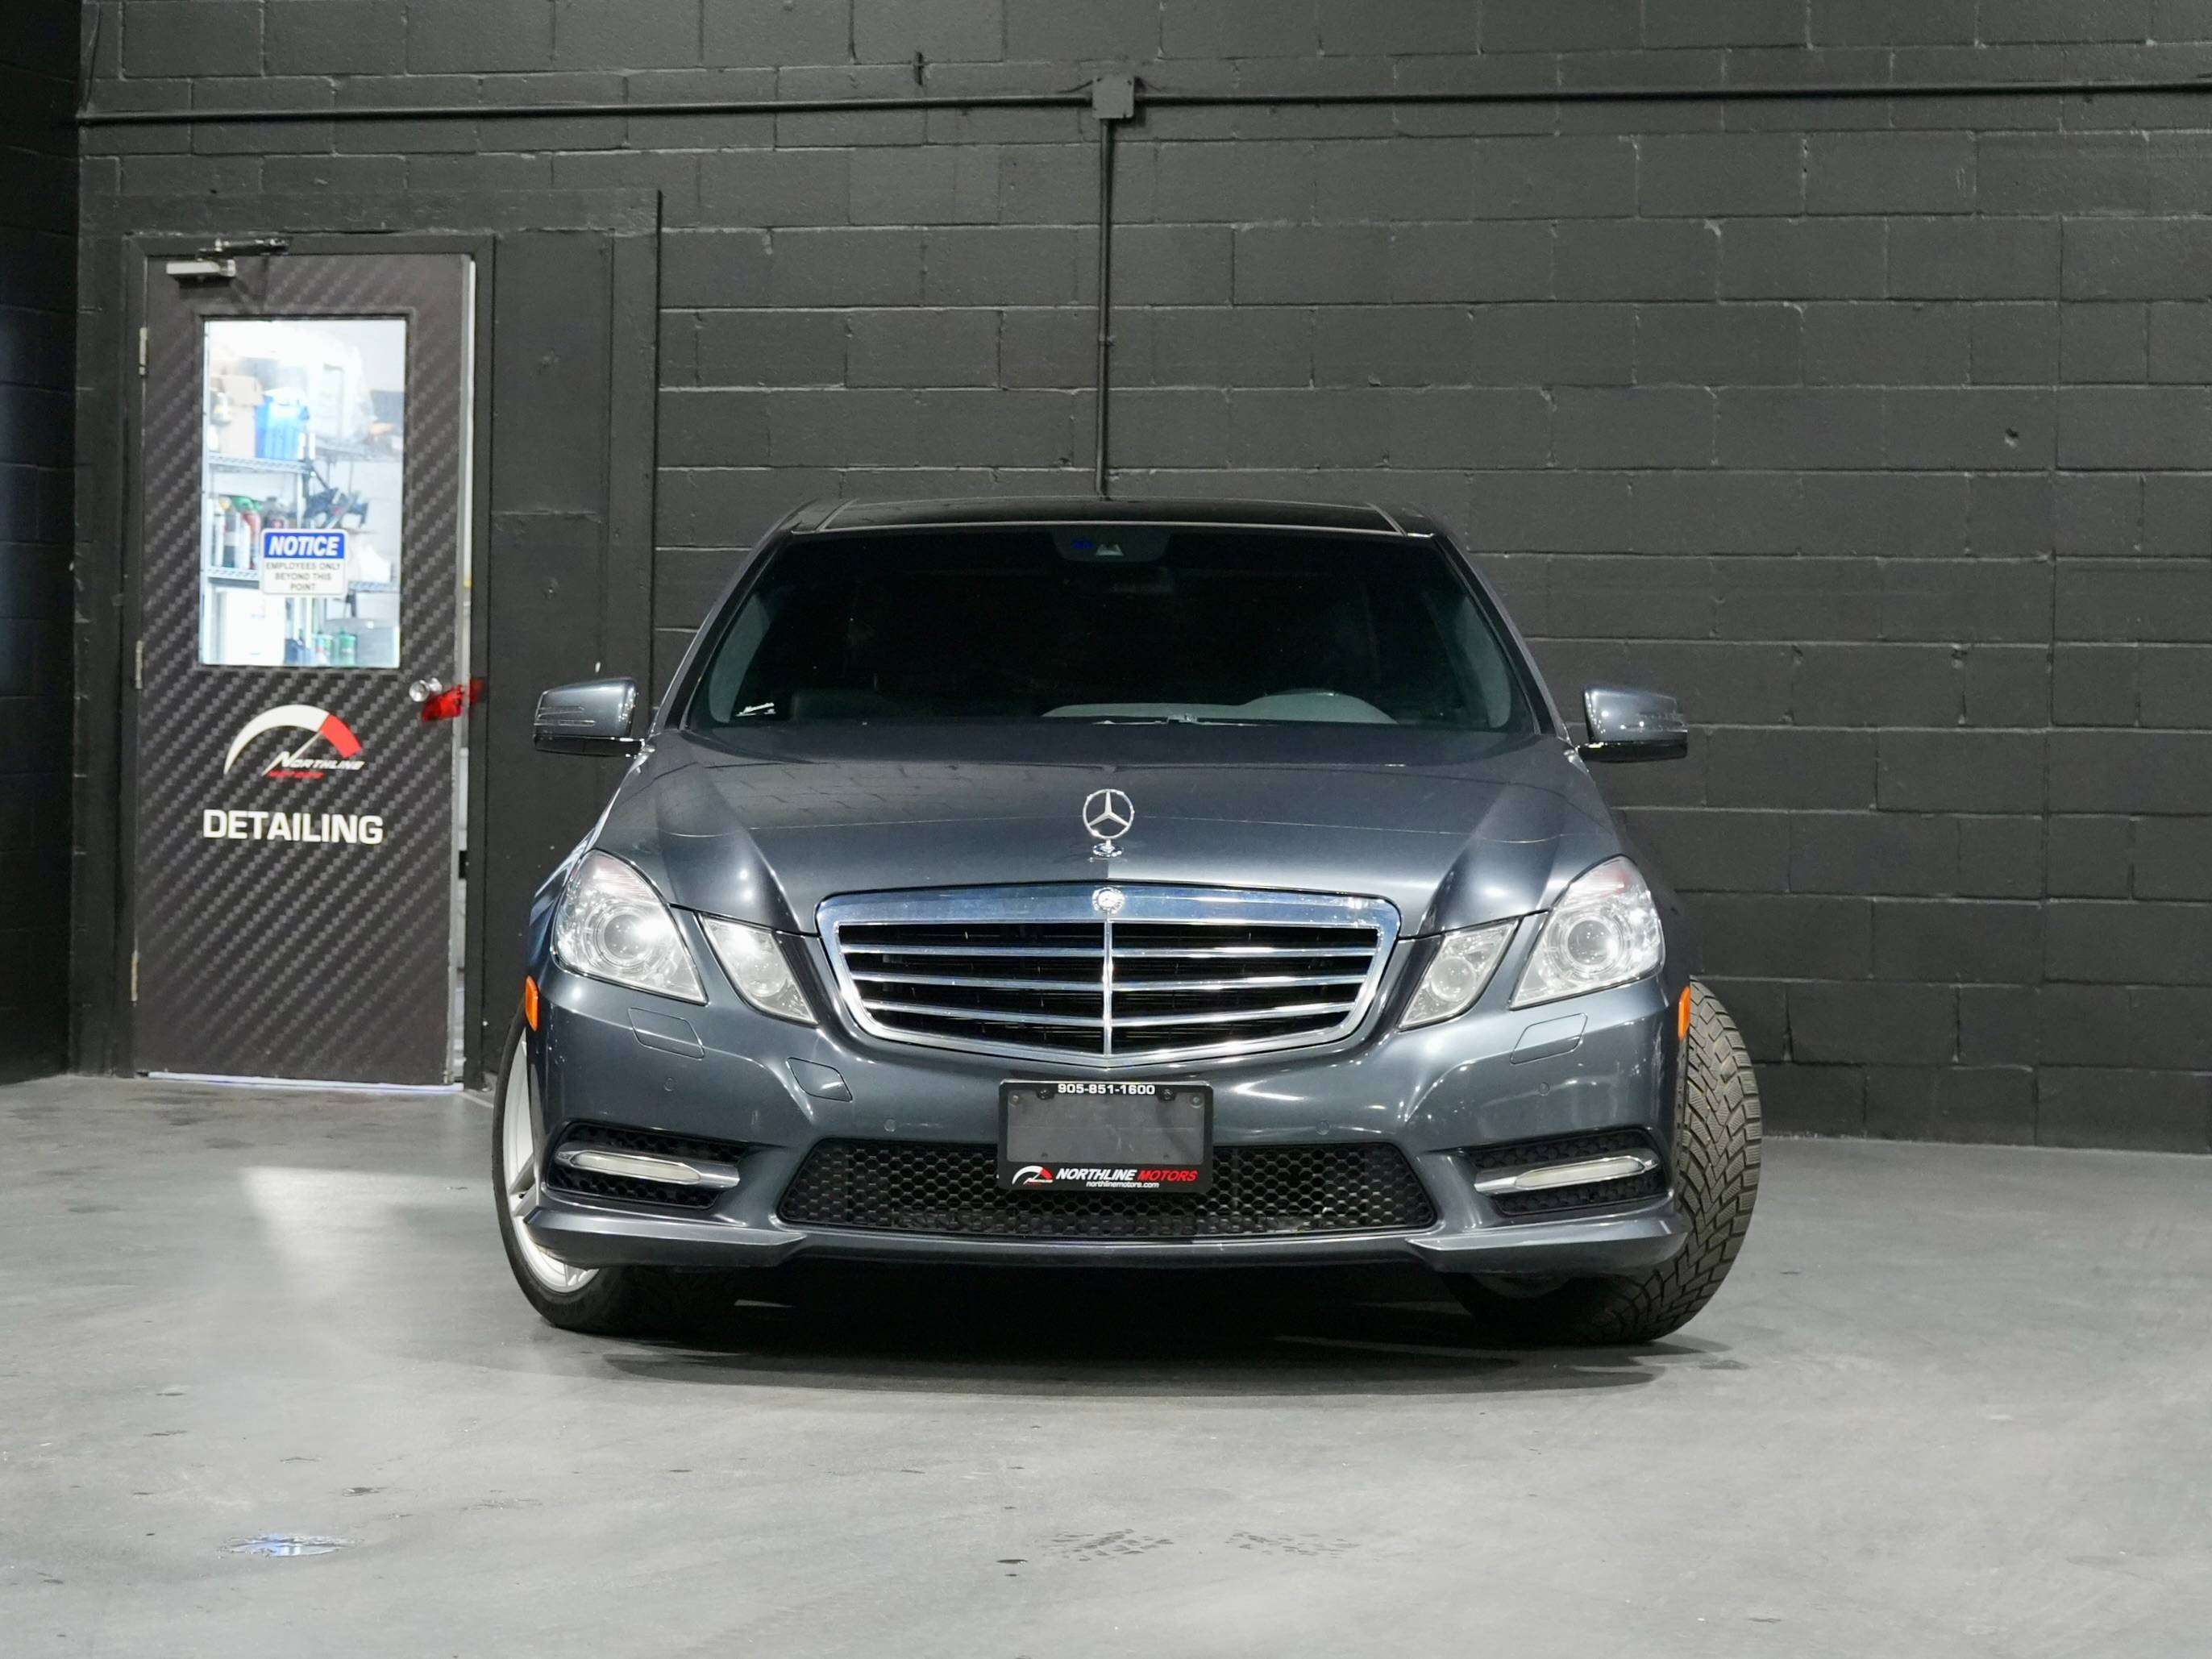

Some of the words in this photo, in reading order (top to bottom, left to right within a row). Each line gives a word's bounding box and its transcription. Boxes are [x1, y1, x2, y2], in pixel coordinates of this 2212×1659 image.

[268, 535, 340, 556] NOTICE
[266, 562, 317, 570] EMPLOYEES
[275, 572, 310, 580] BEYOND
[203, 809, 384, 844] DETAILING
[1058, 1083, 1156, 1095] 905-851-1600
[1055, 1168, 1137, 1181] NORTHLINE
[1137, 1170, 1198, 1182] MOTORS
[1086, 1180, 1159, 1188] northlinemotors.com
